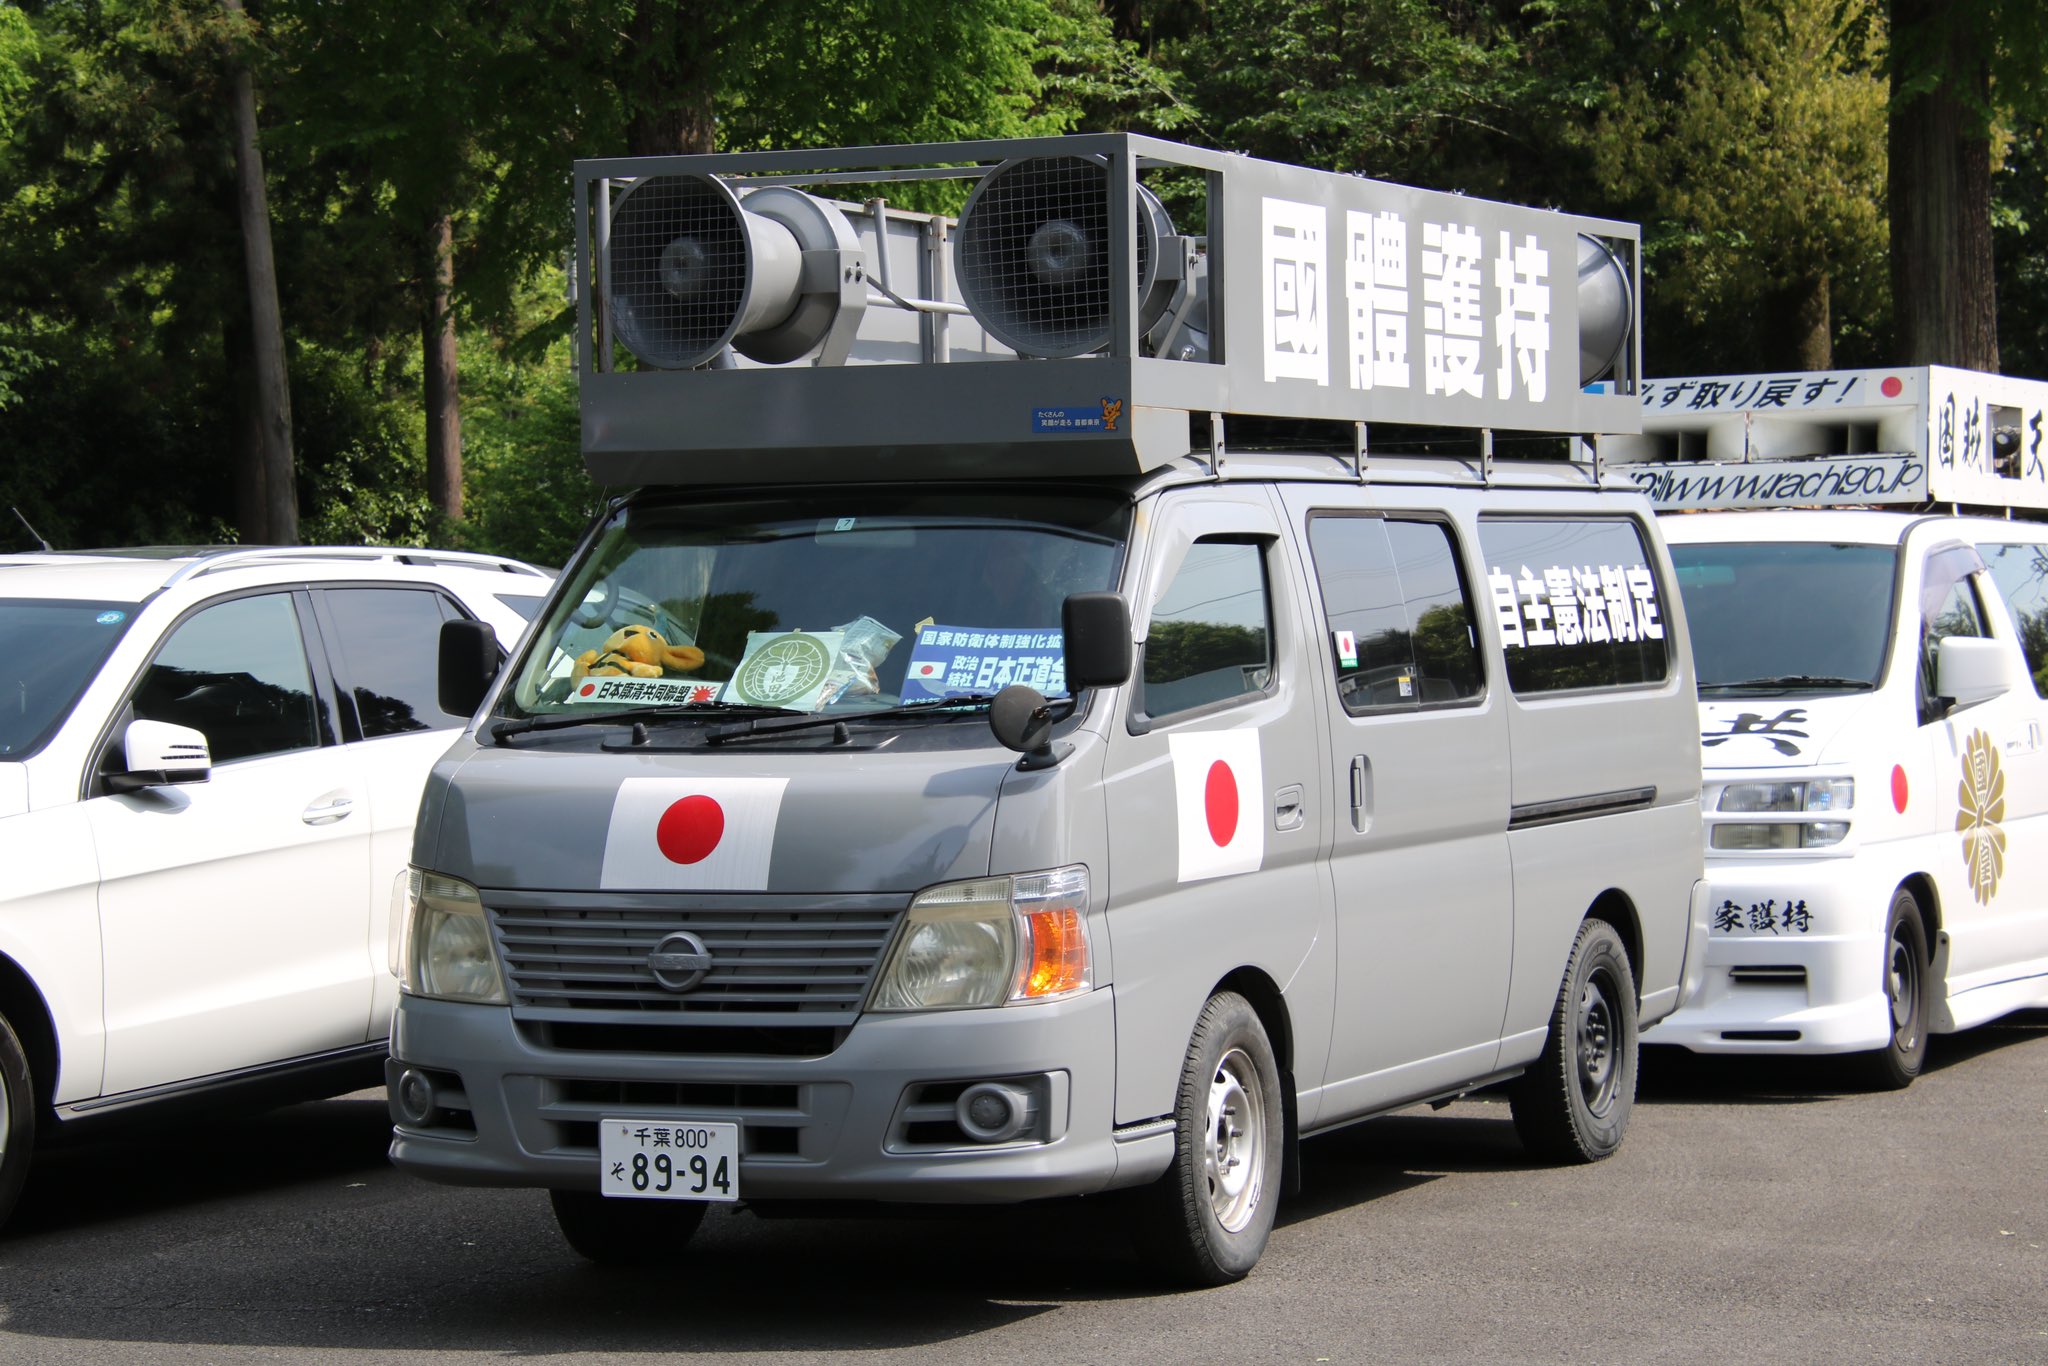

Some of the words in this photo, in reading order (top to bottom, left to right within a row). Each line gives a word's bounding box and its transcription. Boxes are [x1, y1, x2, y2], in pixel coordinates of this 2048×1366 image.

[1262, 196, 1550, 403] 國體護持
[1630, 459, 1924, 502] p://www.rachi.go.jp
[1488, 564, 1664, 649] 自主憲法制定
[920, 630, 1064, 649] 国家防衛体制強化拡
[952, 655, 980, 671] 政治
[946, 672, 976, 688] 結社
[634, 1127, 671, 1148] 千葉
[674, 1128, 708, 1149] 800
[610, 1161, 625, 1182] そ
[632, 1152, 731, 1195] 89-94
